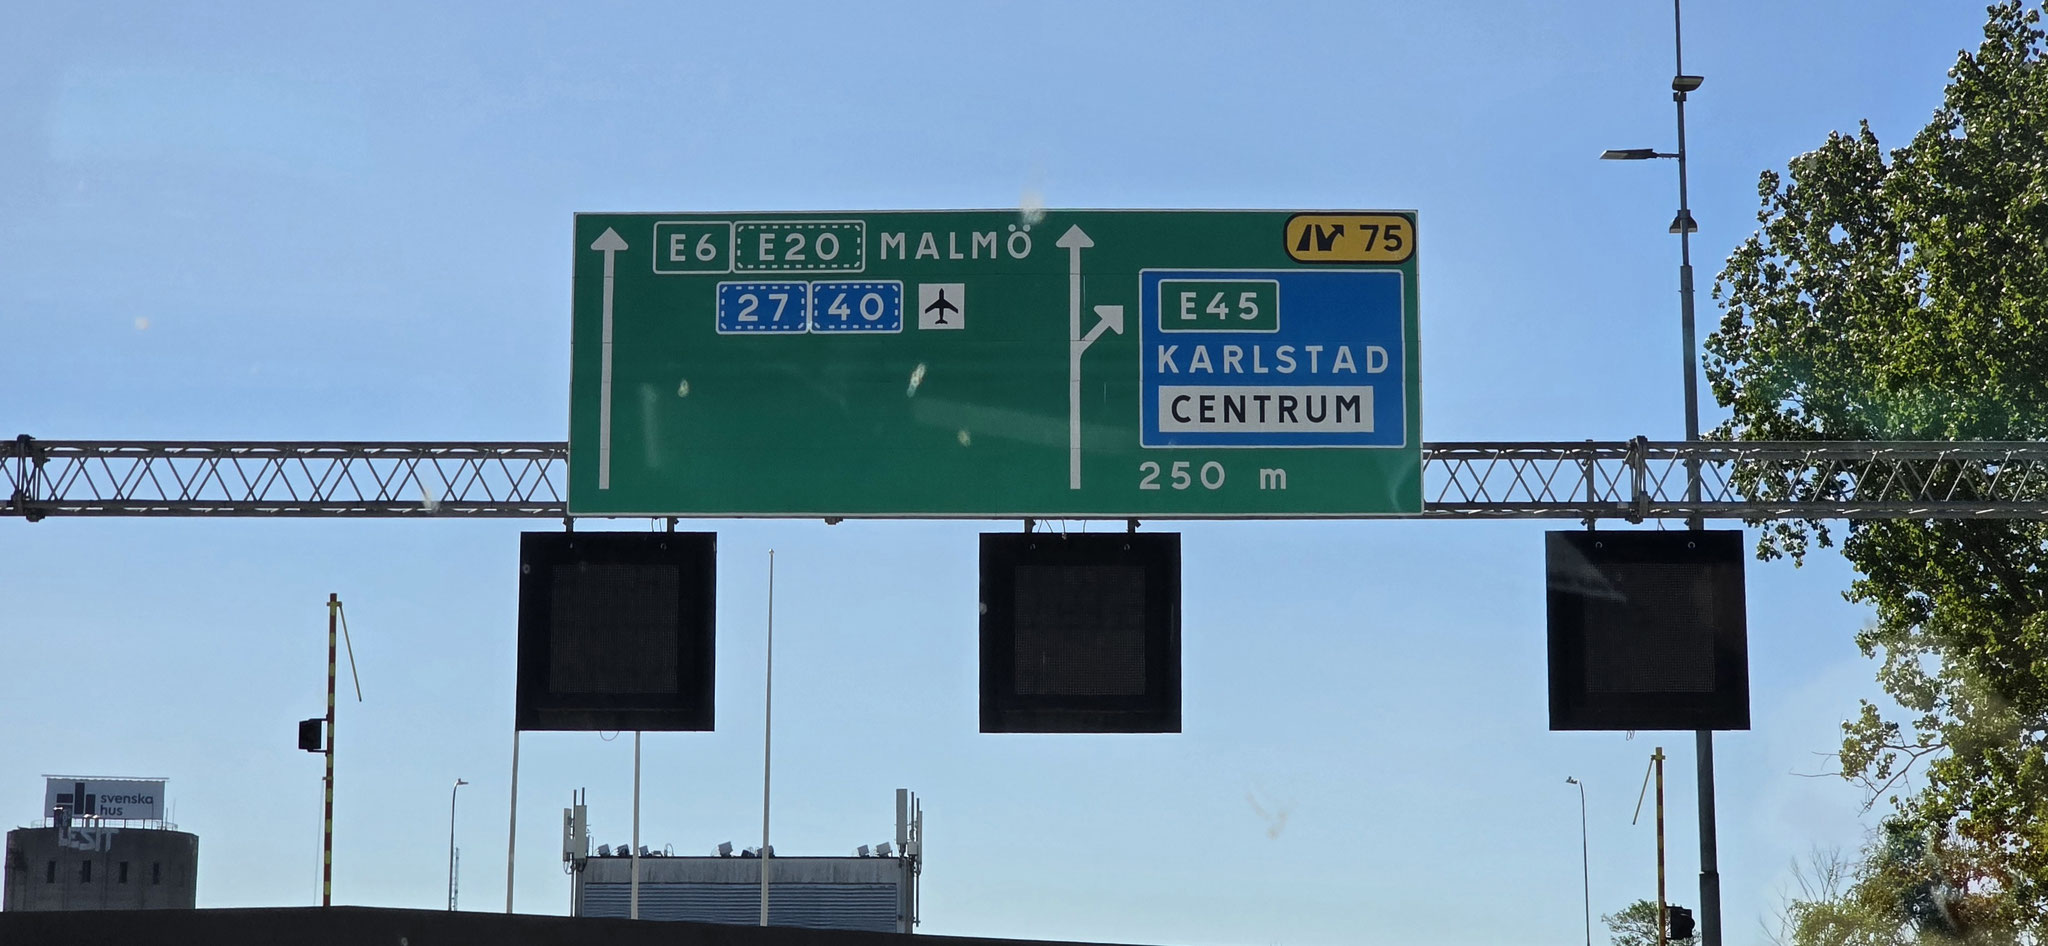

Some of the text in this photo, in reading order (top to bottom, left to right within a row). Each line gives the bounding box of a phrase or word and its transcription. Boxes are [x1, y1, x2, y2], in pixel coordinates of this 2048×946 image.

[669, 223, 1033, 262] E6 E20 MALMÖ
[1359, 224, 1403, 252] 75
[737, 293, 885, 322] 27 40
[1180, 291, 1259, 320] E45
[1157, 344, 1389, 374] KARLSTAD
[1170, 394, 1361, 424] CENTRUM
[1139, 461, 1287, 490] 250 m
[101, 793, 153, 804] svenska
[101, 805, 123, 815] hus
